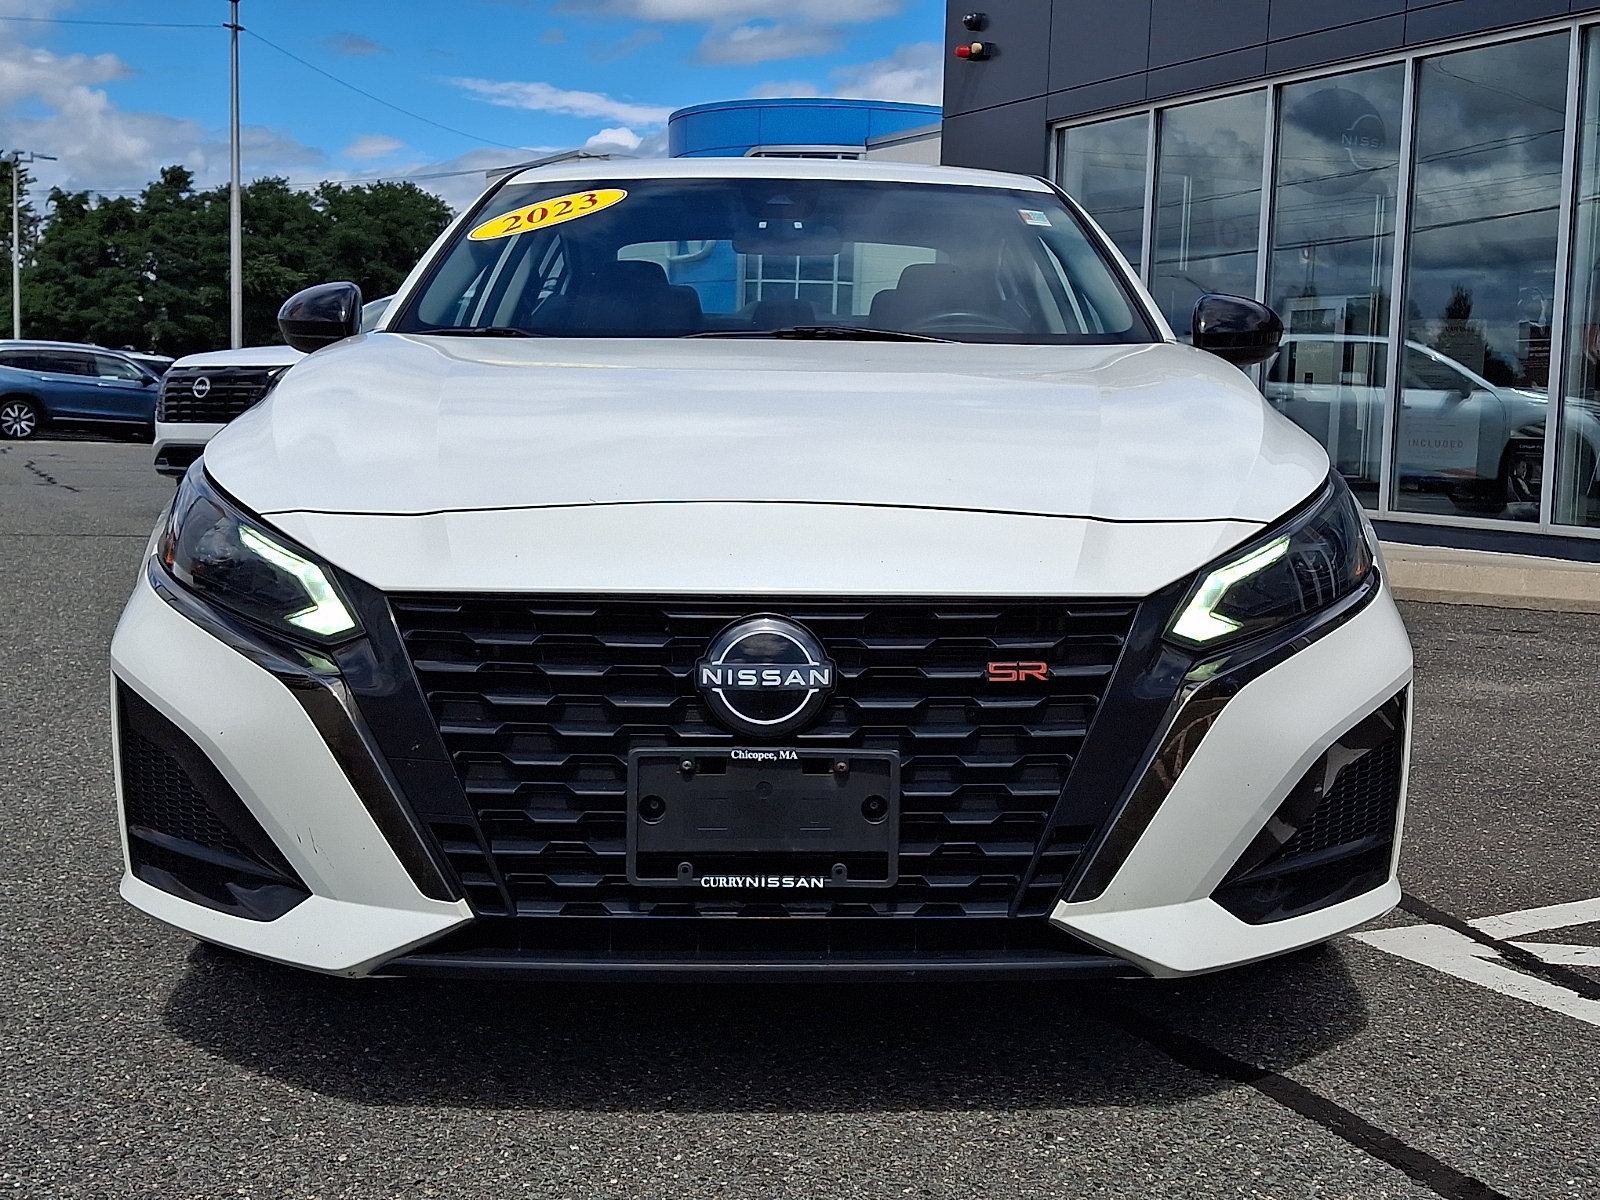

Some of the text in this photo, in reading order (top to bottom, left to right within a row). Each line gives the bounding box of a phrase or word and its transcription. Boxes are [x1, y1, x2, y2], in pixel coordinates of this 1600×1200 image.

[1341, 133, 1384, 149] NISS
[502, 193, 598, 233] 2023
[1408, 439, 1464, 449] INCLUDED
[702, 666, 829, 687] NISSAN
[987, 661, 1049, 682] SR
[731, 750, 798, 761] Chicopee, MA
